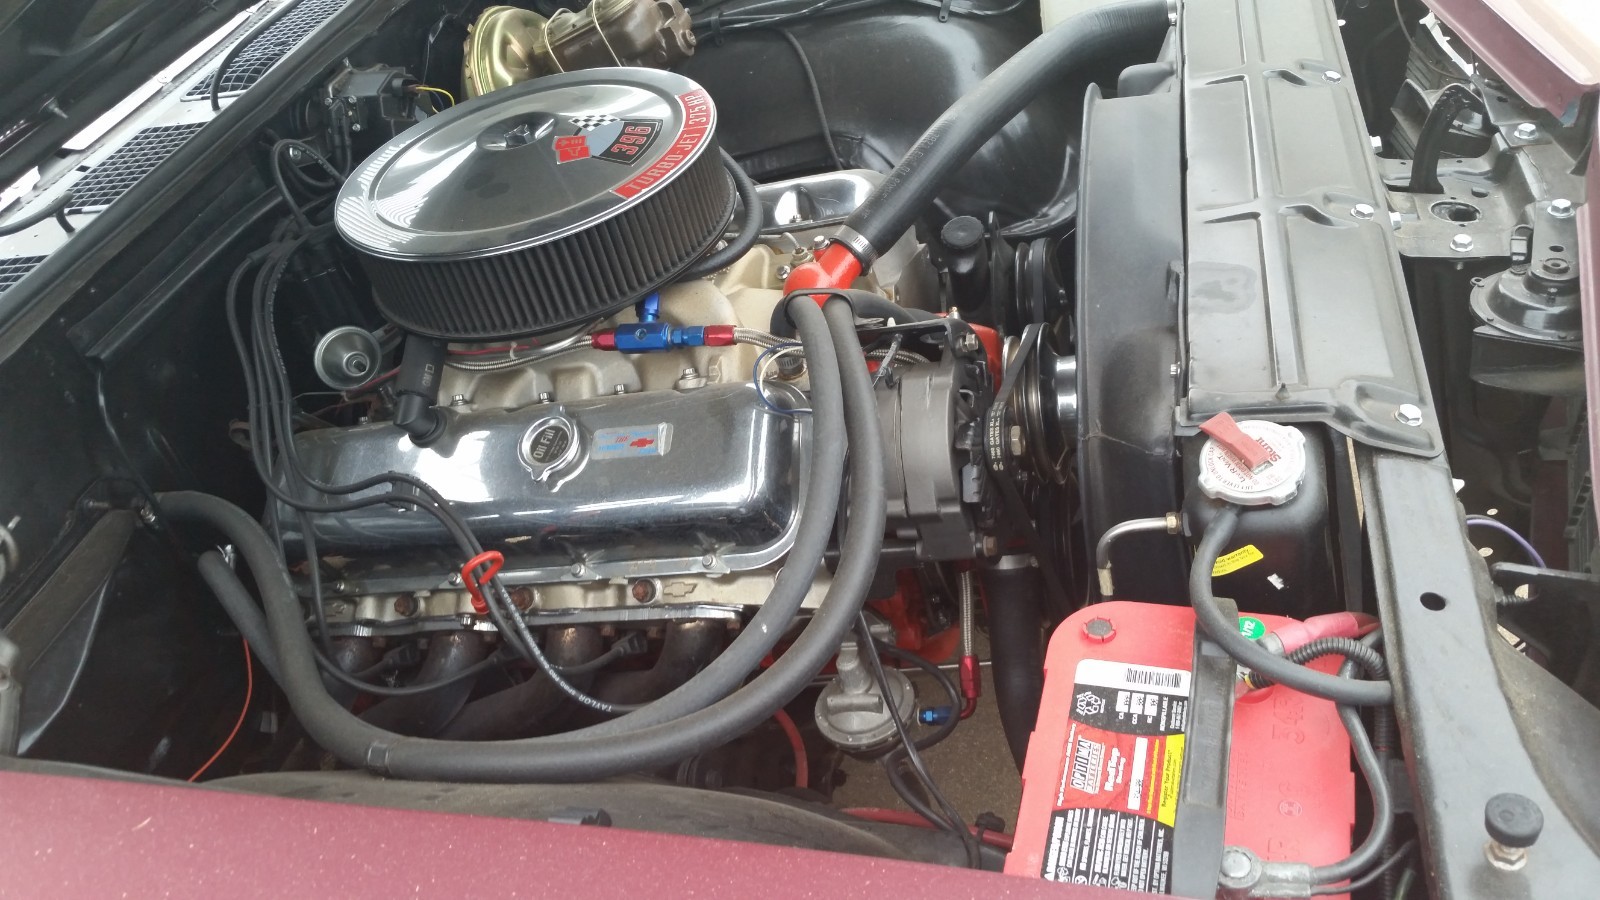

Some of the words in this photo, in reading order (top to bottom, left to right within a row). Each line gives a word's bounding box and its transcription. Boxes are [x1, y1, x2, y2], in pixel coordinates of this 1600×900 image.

[684, 93, 704, 106] HP
[689, 104, 707, 125] 375
[610, 125, 652, 155] 396
[626, 132, 701, 190] TURBO-JET
[533, 446, 545, 459] Oil
[544, 428, 556, 447] Fill
[548, 669, 561, 682] PRO
[560, 680, 576, 696] SPIRO
[578, 693, 612, 712] TAYLOR
[1070, 740, 1092, 790] OPTIMA
[1085, 743, 1100, 792] BATTERIES
[1105, 748, 1120, 791] RedTop
